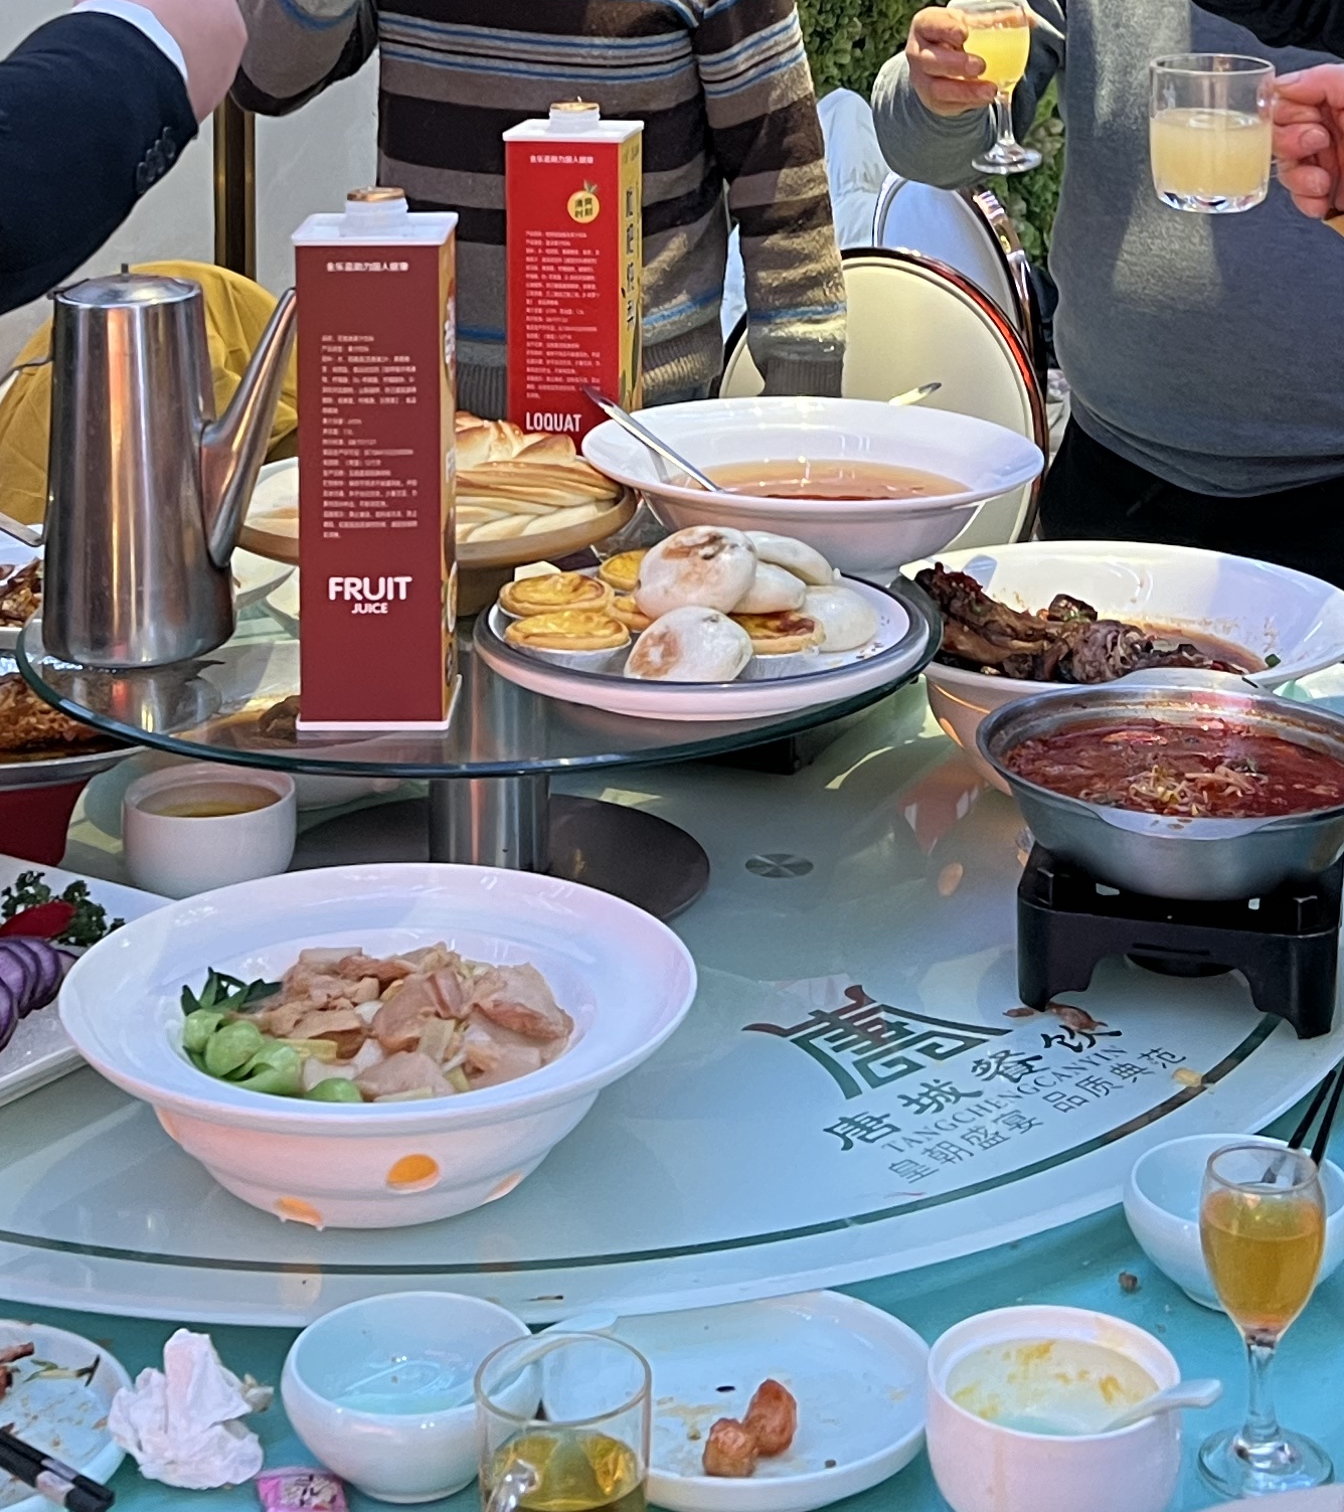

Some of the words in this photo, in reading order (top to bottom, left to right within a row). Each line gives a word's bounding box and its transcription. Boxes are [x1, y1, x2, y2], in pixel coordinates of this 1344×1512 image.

[526, 412, 582, 432] LOQUAT
[328, 576, 413, 601] FRUIT
[351, 602, 388, 615] JUICE
[822, 1025, 1123, 1152] 唐城餐饮
[881, 1044, 1130, 1154] TANGCHENGCANYIN
[887, 1108, 1045, 1185] 皇朝盛宴
[1041, 1046, 1187, 1115] 品质典范
